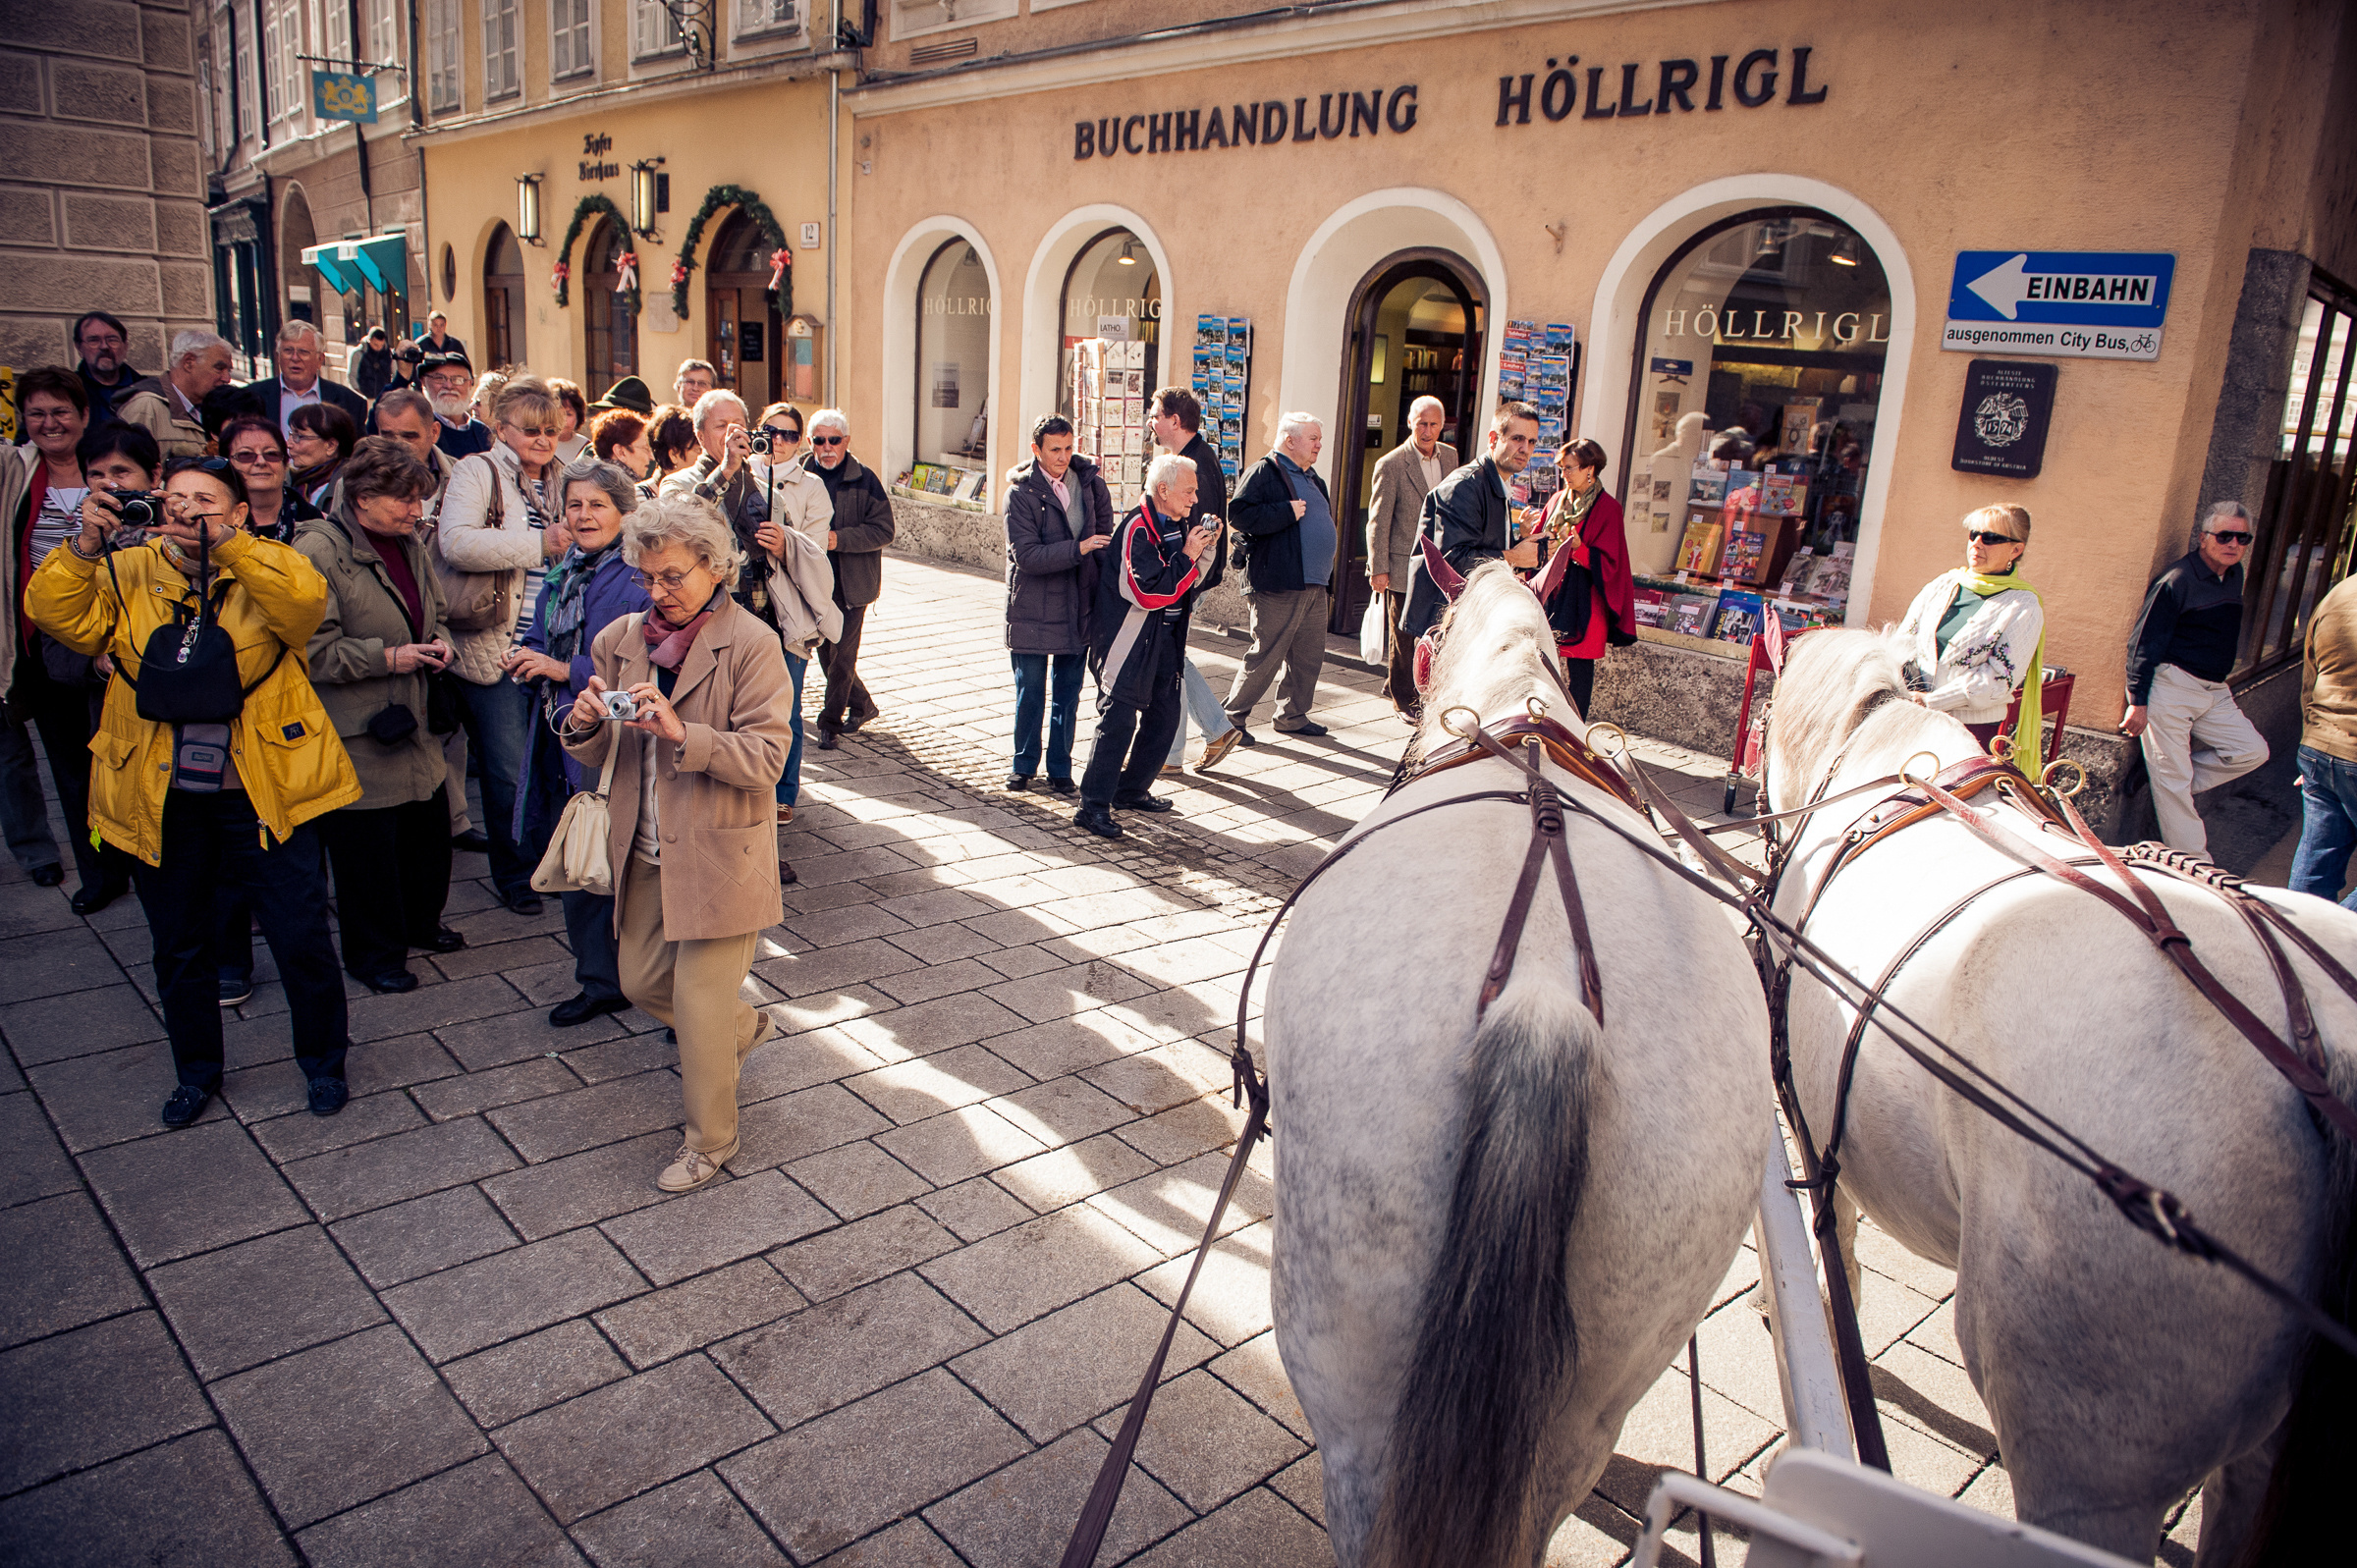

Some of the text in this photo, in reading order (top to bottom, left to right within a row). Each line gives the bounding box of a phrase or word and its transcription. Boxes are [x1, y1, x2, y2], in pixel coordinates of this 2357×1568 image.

[1073, 47, 1828, 160] BUCHHANDLUNG HÖLLRIGL
[805, 225, 814, 240] 12
[2026, 277, 2149, 301] EINBAHN
[1662, 304, 1891, 343] HÖLLRIGL
[1947, 328, 2129, 352] ausgenommen City Bus,
